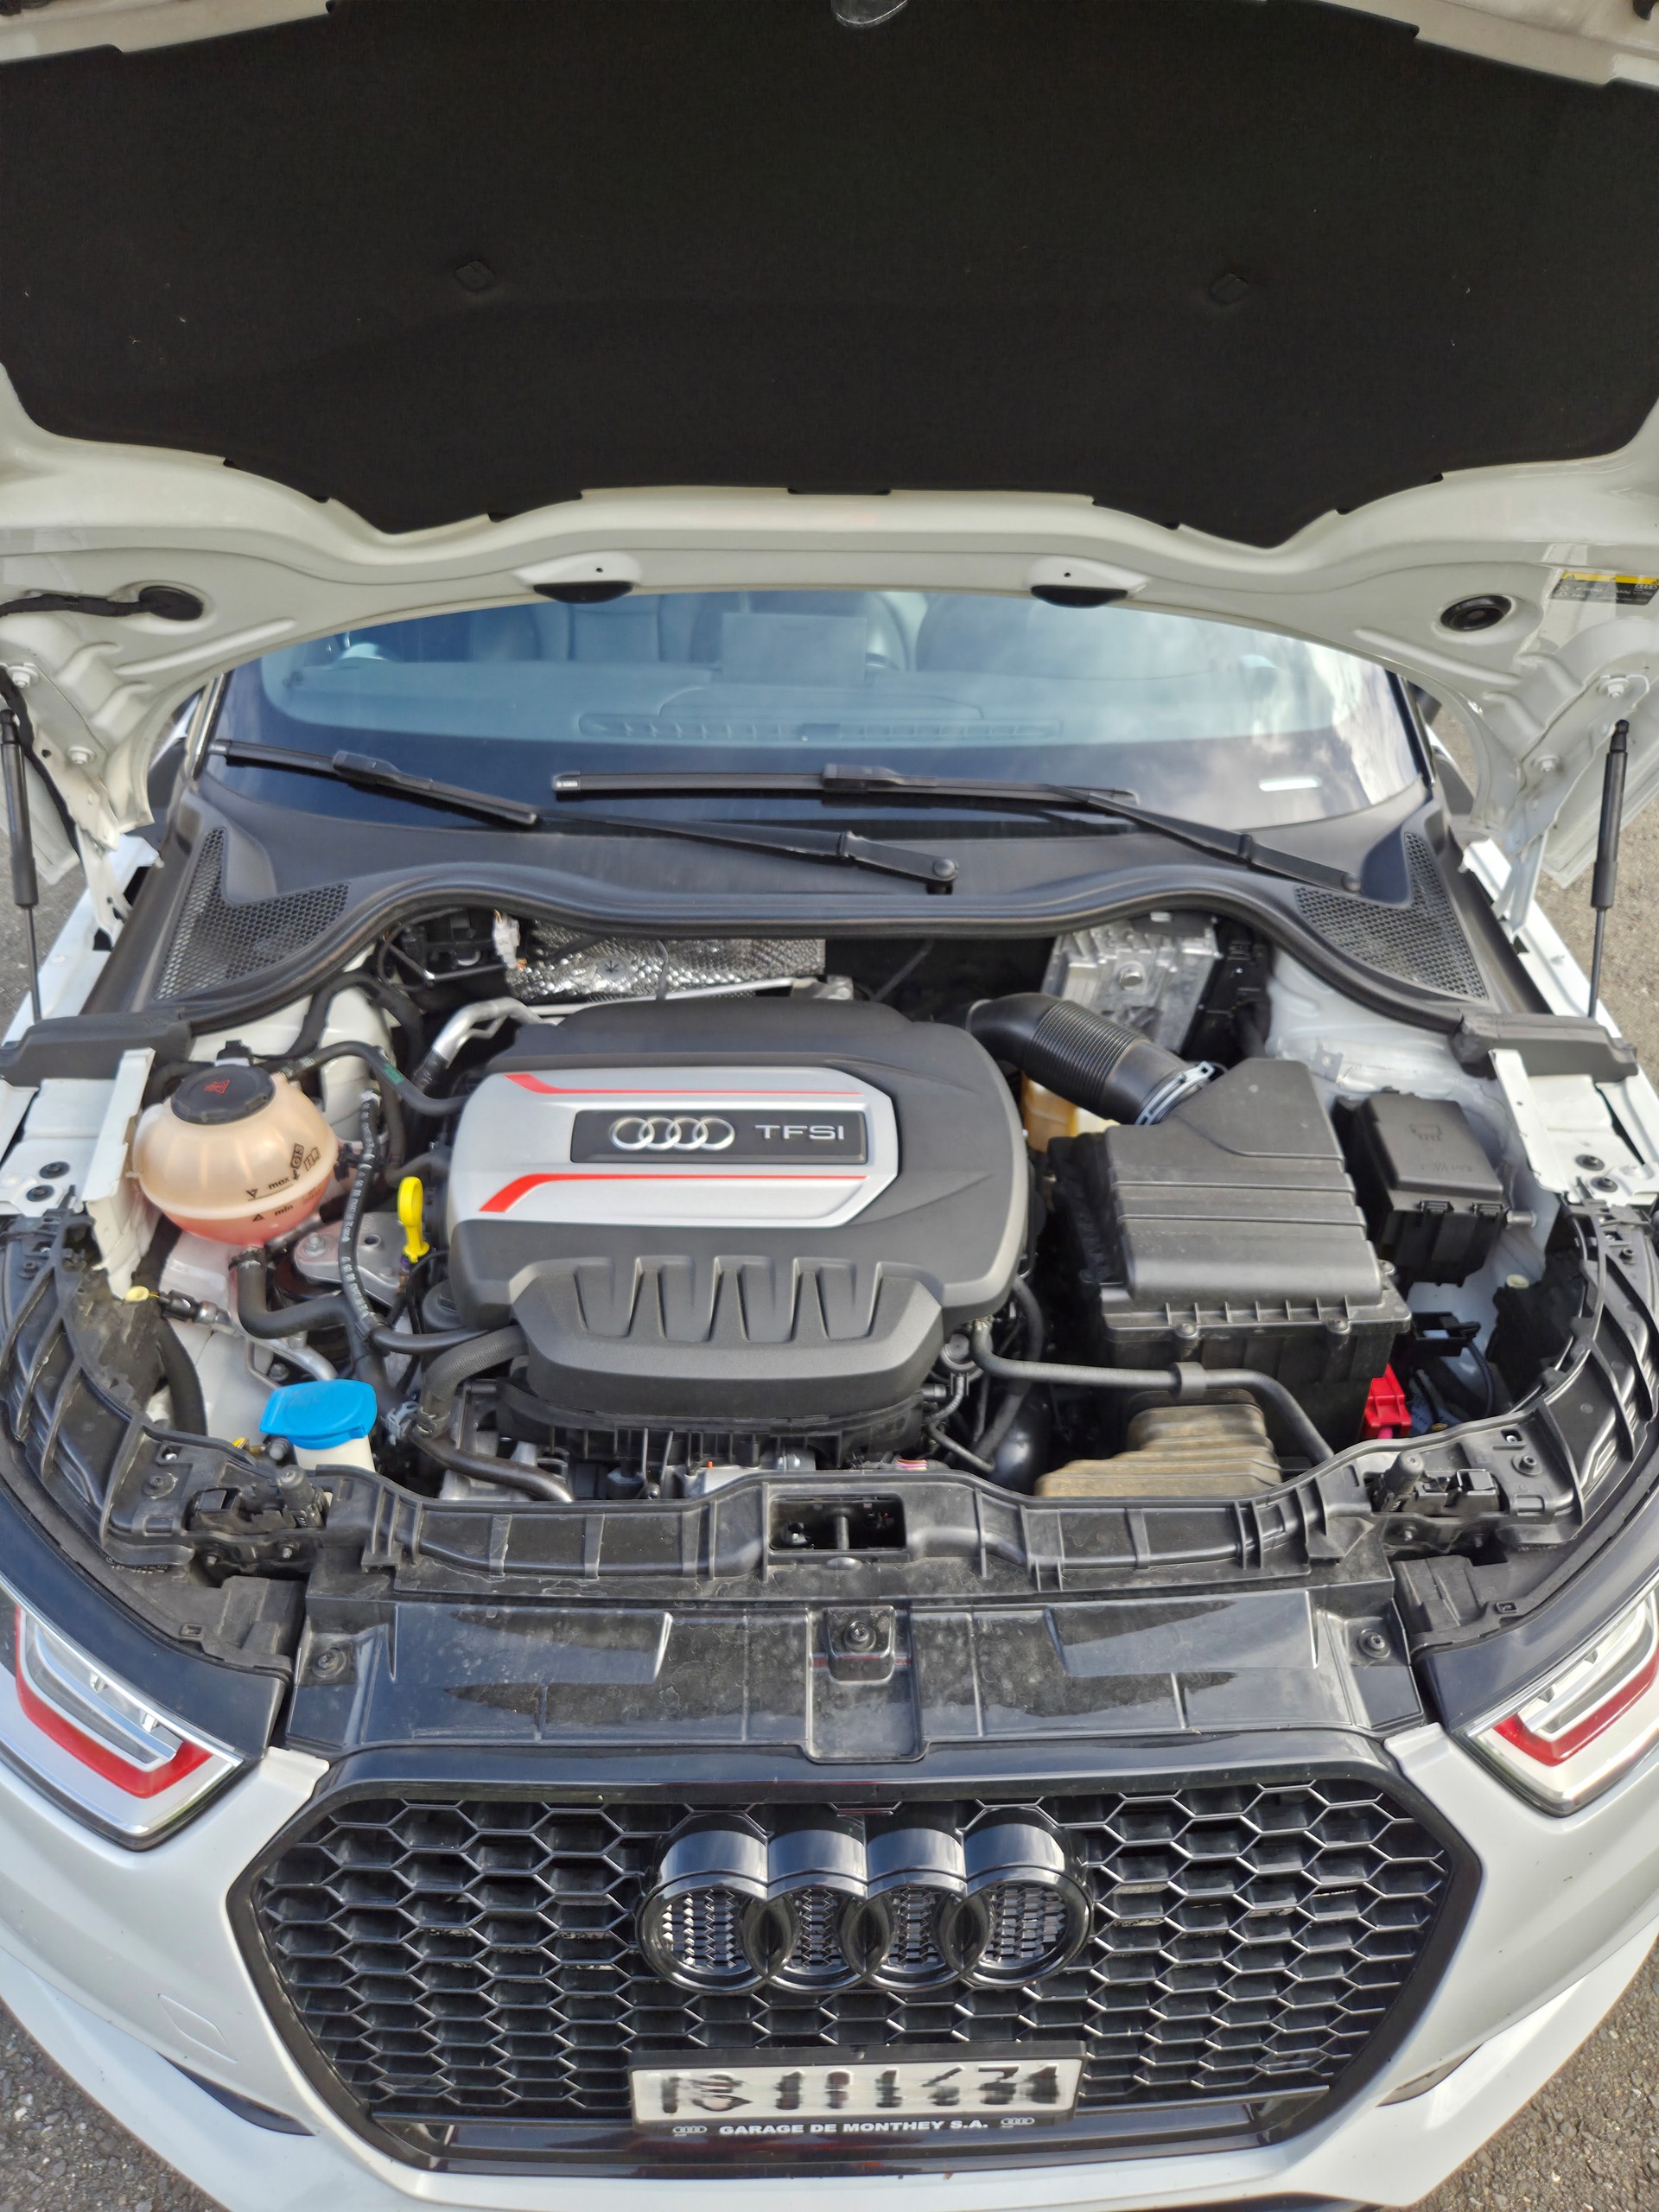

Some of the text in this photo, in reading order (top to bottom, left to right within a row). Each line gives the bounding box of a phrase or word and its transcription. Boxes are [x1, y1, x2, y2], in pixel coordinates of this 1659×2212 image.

[754, 1124, 845, 1140] TFSI
[268, 1176, 290, 1190] max
[274, 1204, 294, 1217] min
[718, 2120, 989, 2135] GARAGE DE MONTHEY S.A.
